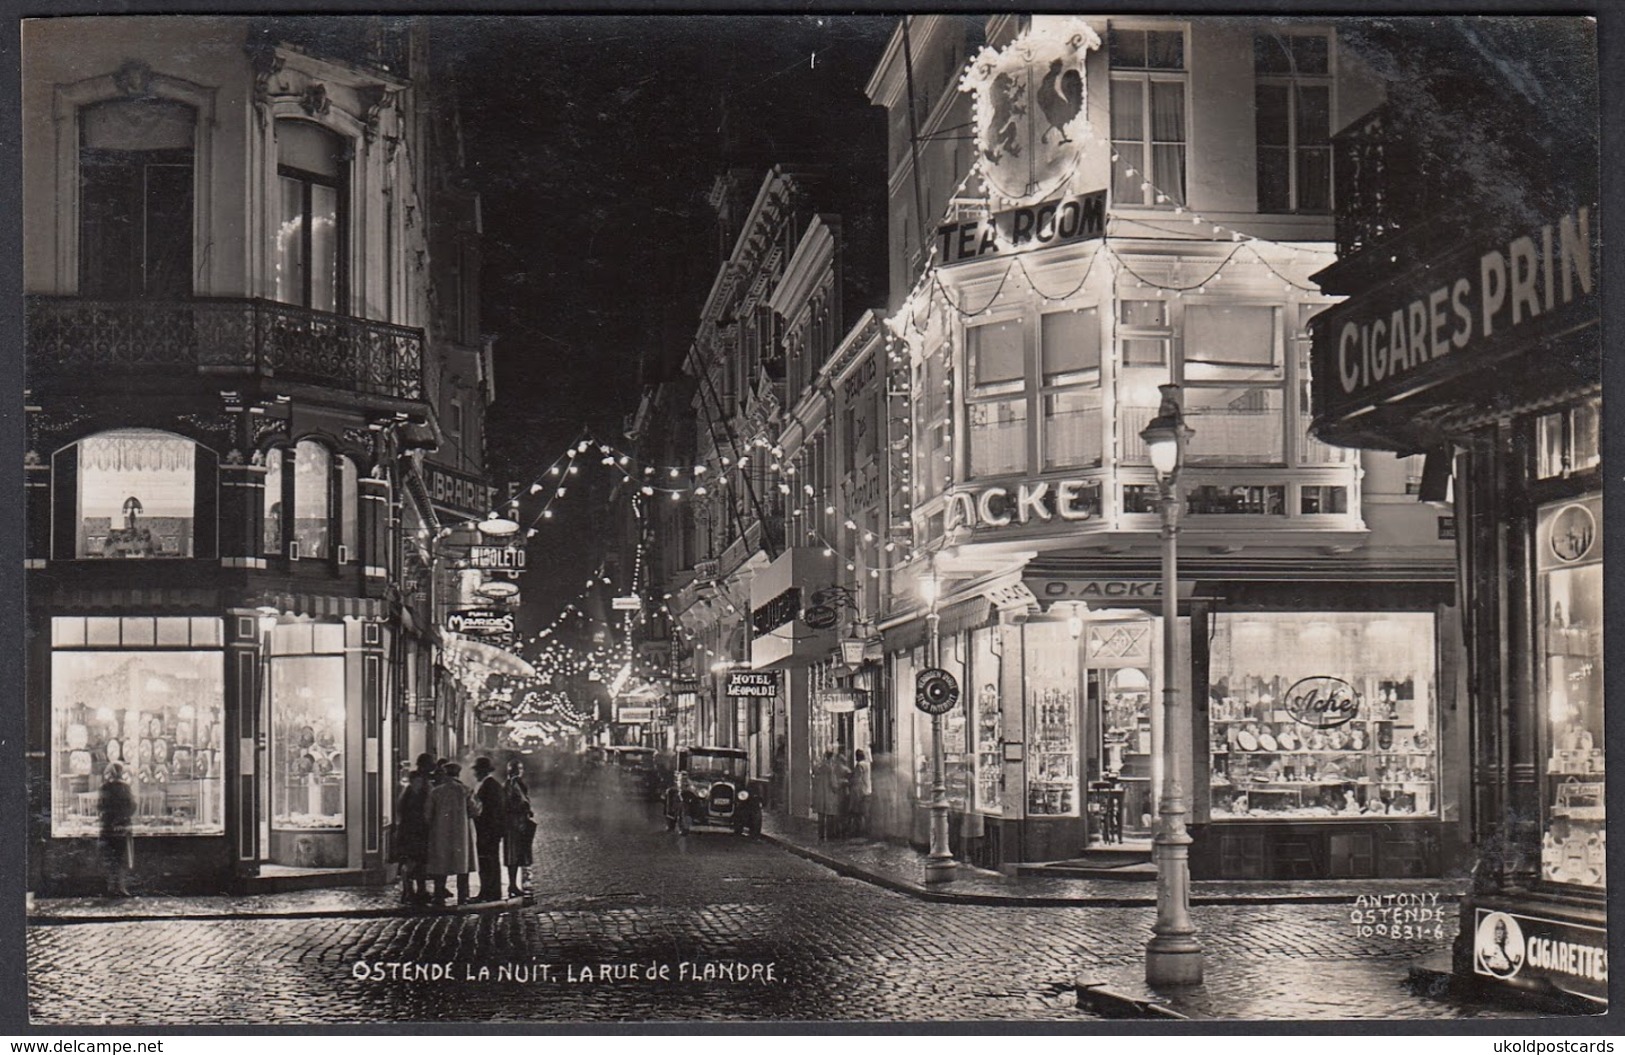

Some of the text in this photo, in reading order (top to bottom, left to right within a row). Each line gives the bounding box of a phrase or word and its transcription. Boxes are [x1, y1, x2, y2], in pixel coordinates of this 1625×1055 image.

[937, 197, 1104, 262] TEA ROOM
[1338, 205, 1592, 394] CIGARES PRIN
[944, 479, 1091, 535] ACKE
[727, 684, 777, 697] LEOPOLD II
[731, 674, 771, 685] HOTEL
